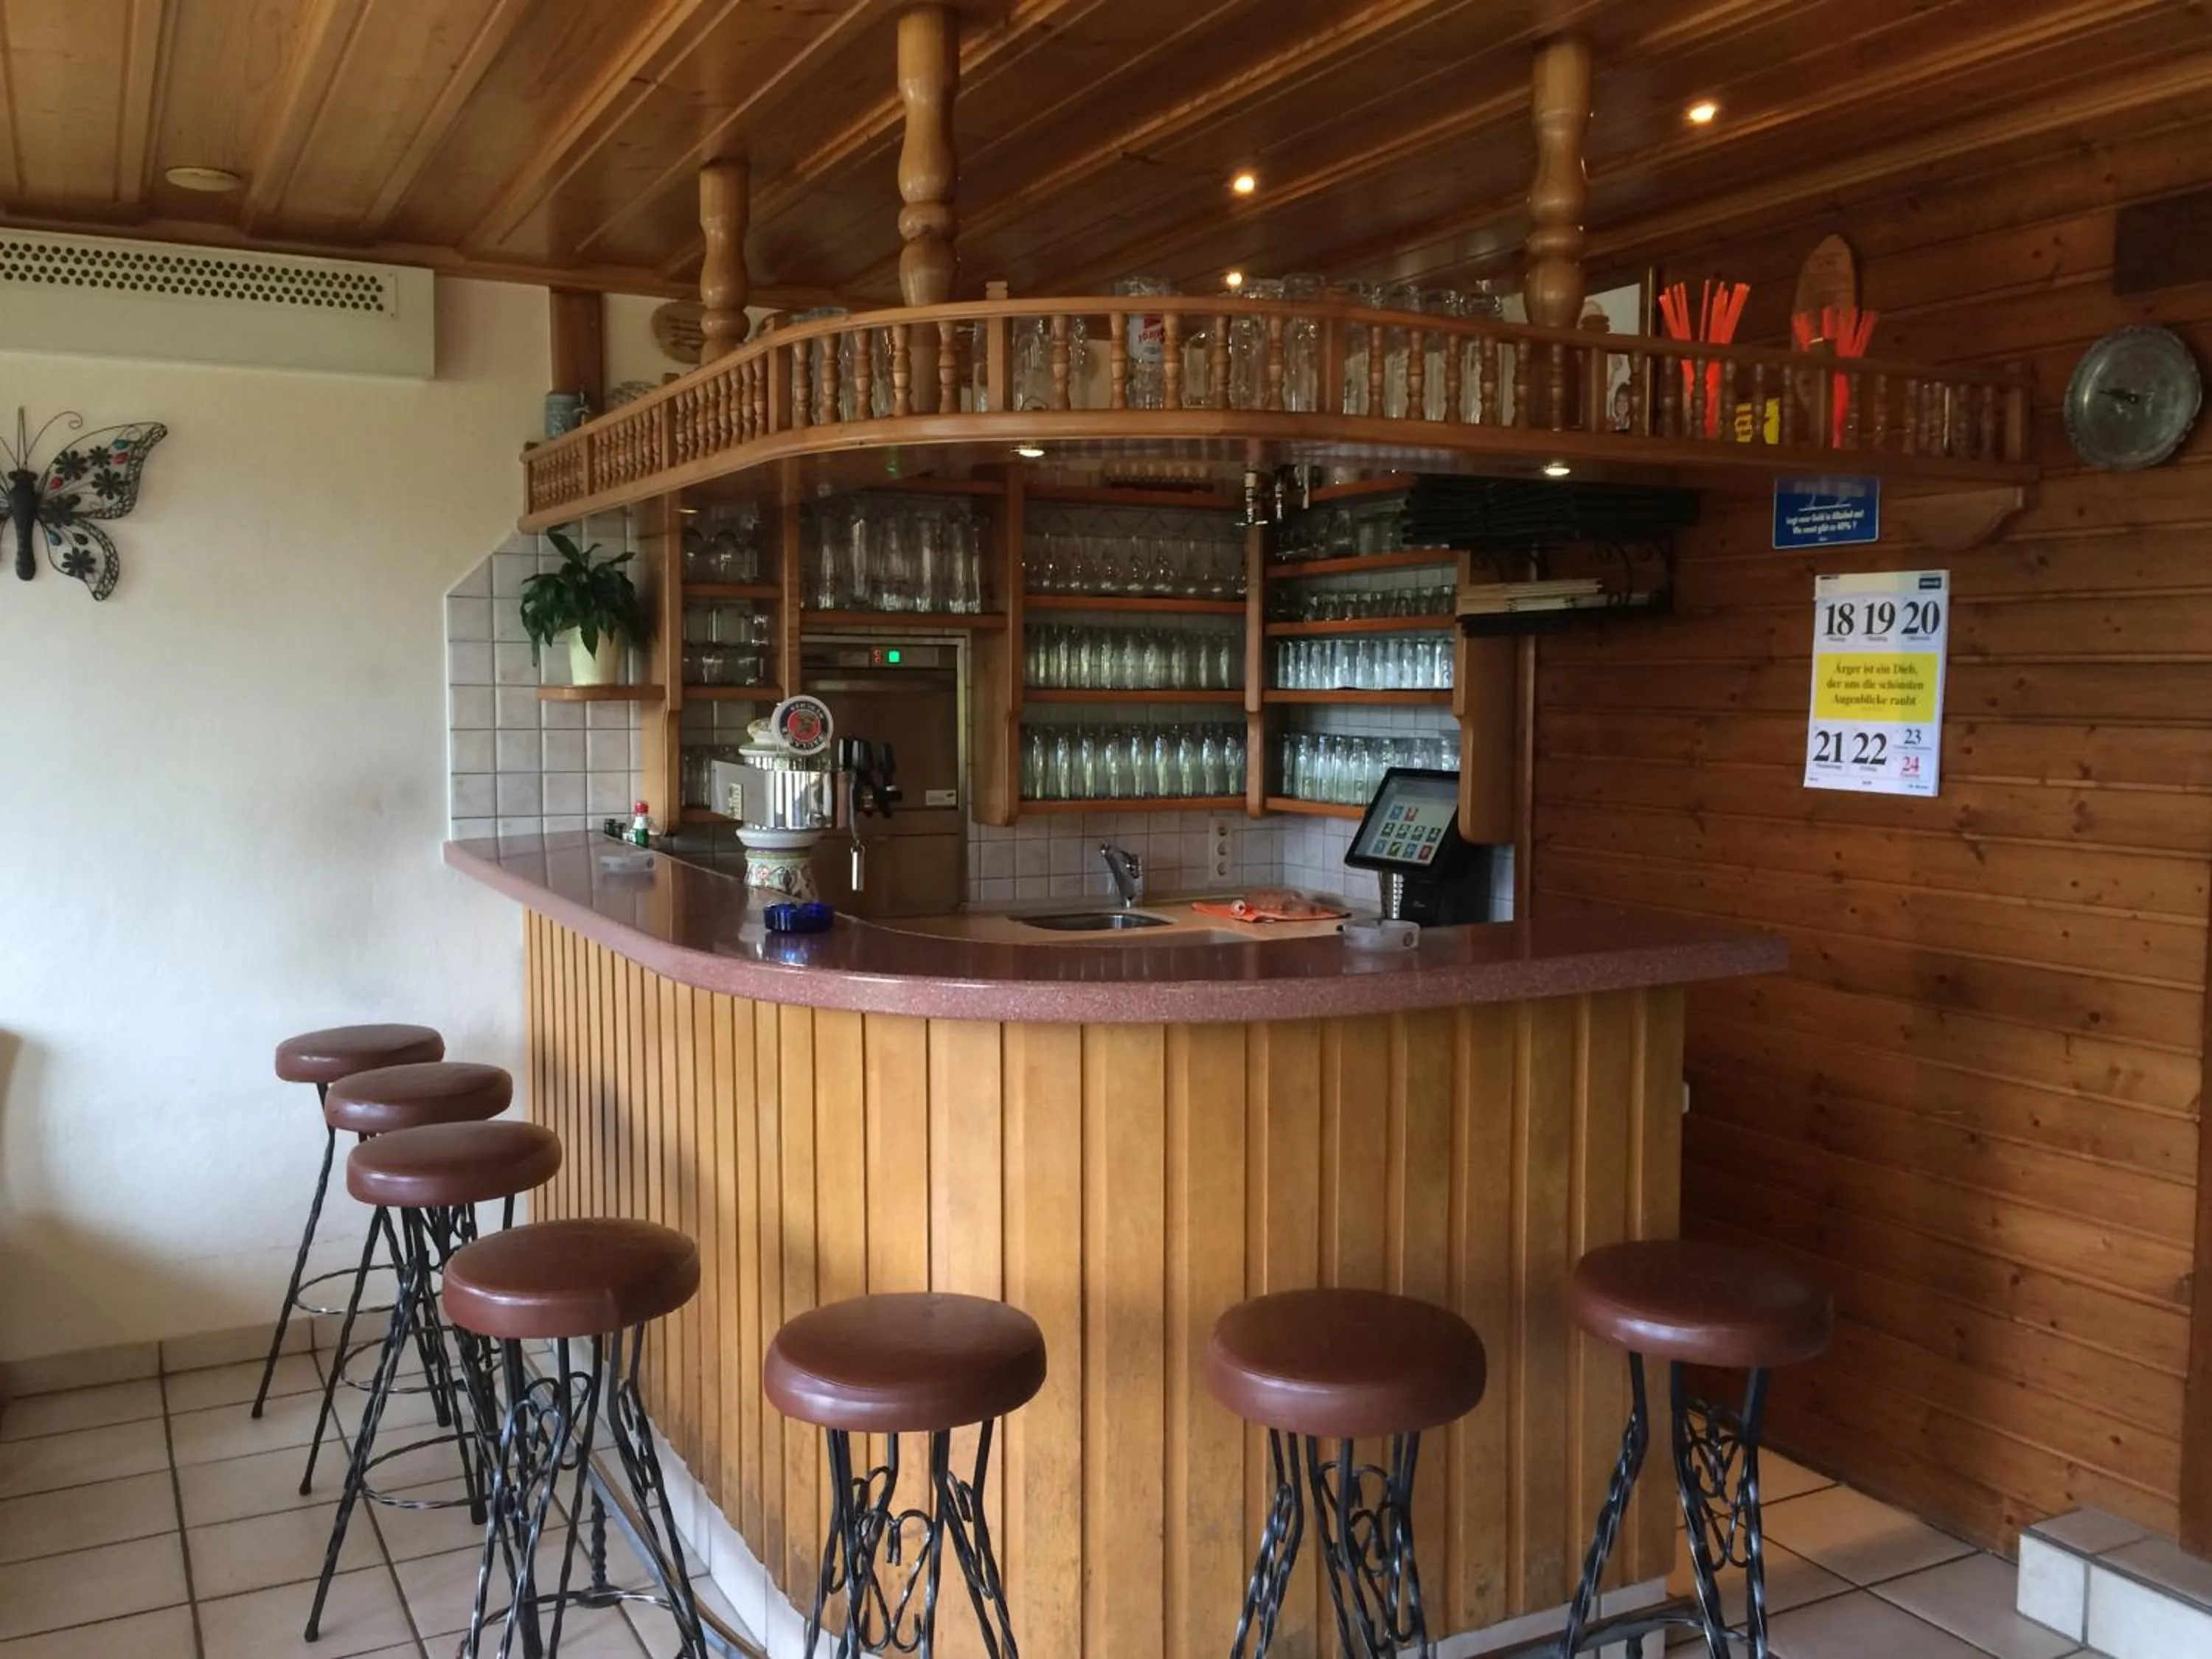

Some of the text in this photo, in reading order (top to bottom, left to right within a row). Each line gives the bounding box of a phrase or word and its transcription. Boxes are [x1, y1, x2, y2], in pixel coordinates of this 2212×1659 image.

[1823, 600, 1940, 636] 18 19 20
[1863, 663, 1874, 674] ist
[1877, 664, 1891, 674] ein
[1826, 677, 1842, 689] der
[1903, 728, 1922, 745] 23
[1812, 729, 1888, 765] 21 22
[1902, 756, 1920, 773] 24
